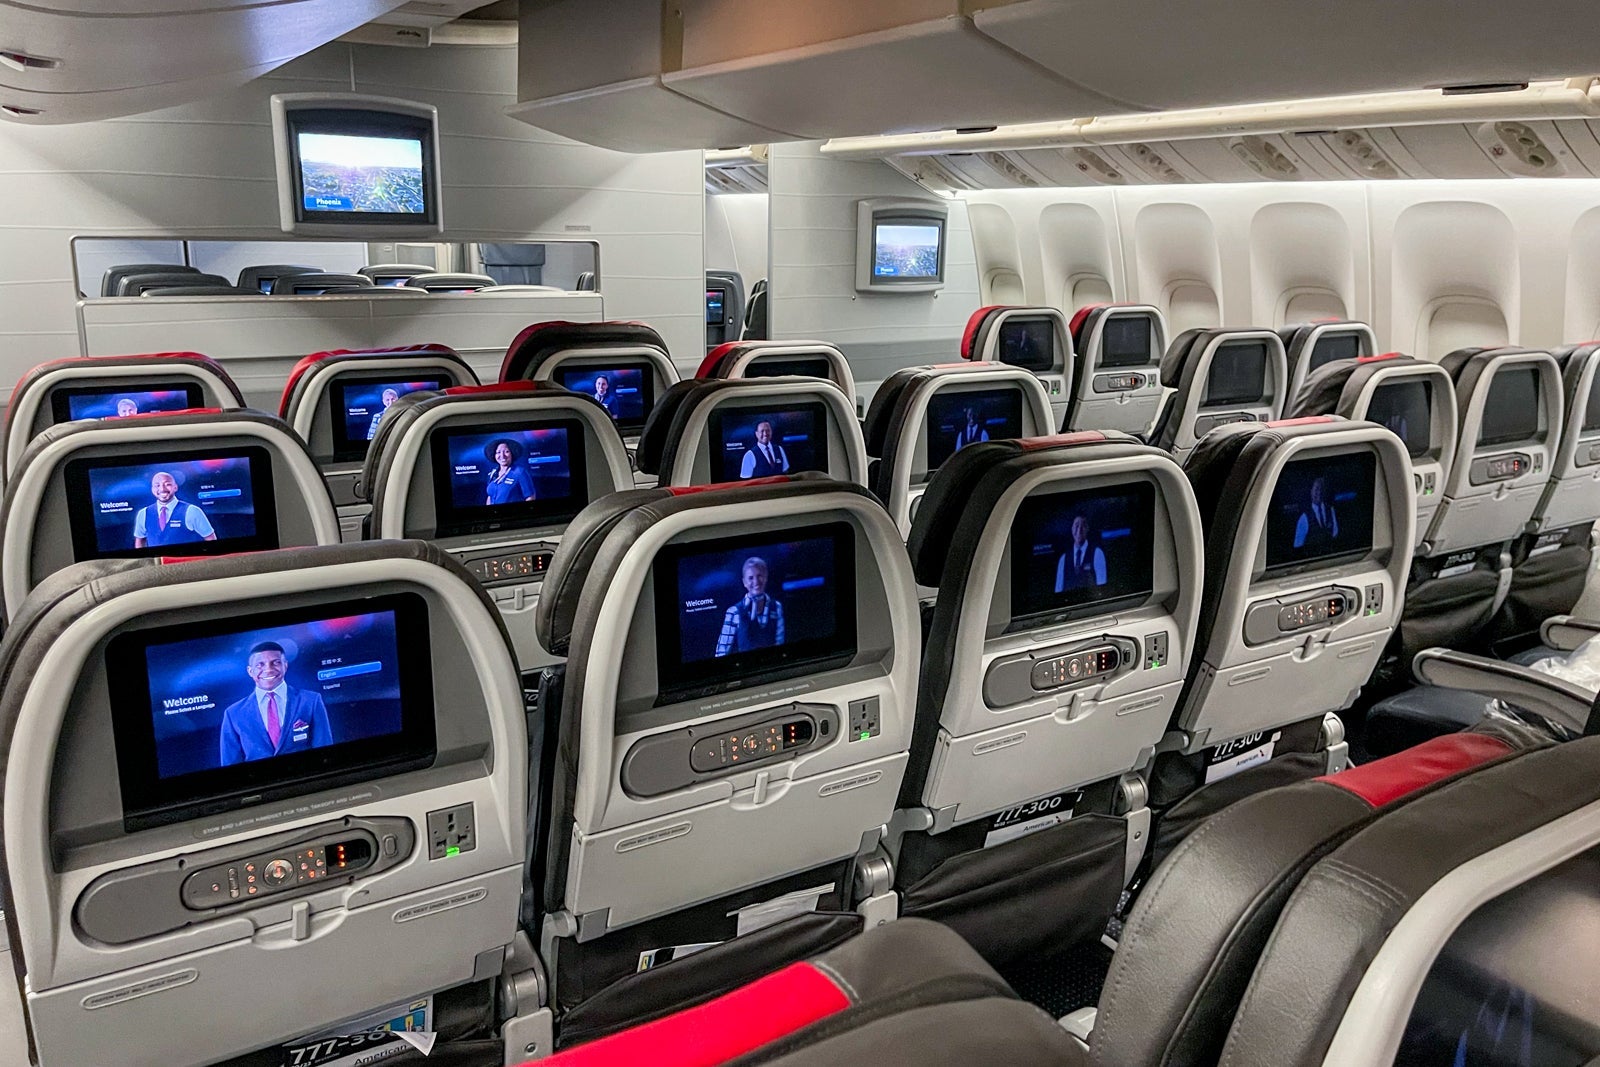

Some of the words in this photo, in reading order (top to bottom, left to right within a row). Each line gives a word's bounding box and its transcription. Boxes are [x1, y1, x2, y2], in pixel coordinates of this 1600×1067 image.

[316, 198, 342, 206] Phoenix
[100, 501, 128, 509] Welcome
[685, 598, 714, 607] Welcome
[320, 671, 337, 679] English
[163, 694, 209, 708] Welcome
[1214, 731, 1263, 757] 777-300
[996, 796, 1062, 823] 777-300
[203, 826, 220, 835] STOW
[221, 823, 234, 831] AND
[290, 1031, 398, 1064] 777-30
[354, 1044, 408, 1066] American
